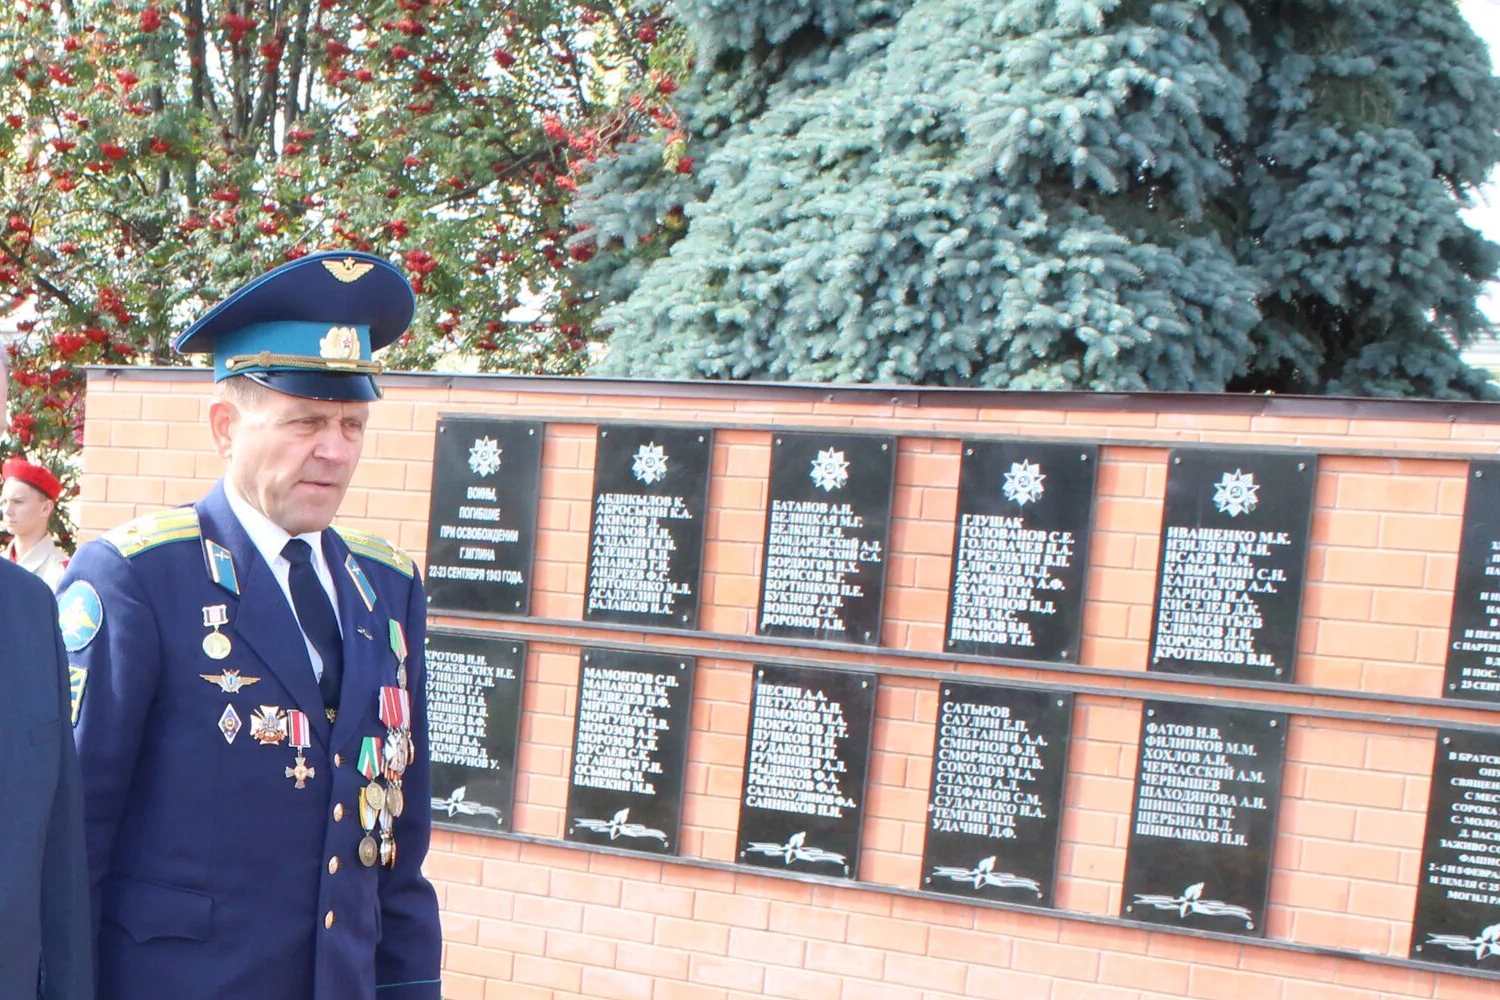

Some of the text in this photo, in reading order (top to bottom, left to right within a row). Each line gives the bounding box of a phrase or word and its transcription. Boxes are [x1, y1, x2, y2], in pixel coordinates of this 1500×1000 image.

[467, 487, 496, 502] ВОИНЫ,
[459, 506, 500, 521] ПОГИБШИЕ
[440, 525, 518, 543] ПРИ ОСВОБОЖДЕНИИ
[429, 565, 446, 578] 22-23
[447, 567, 485, 580] СЕНТЯБРЯ
[486, 569, 501, 582] 1943
[943, 702, 1010, 718] САТЫРОВ
